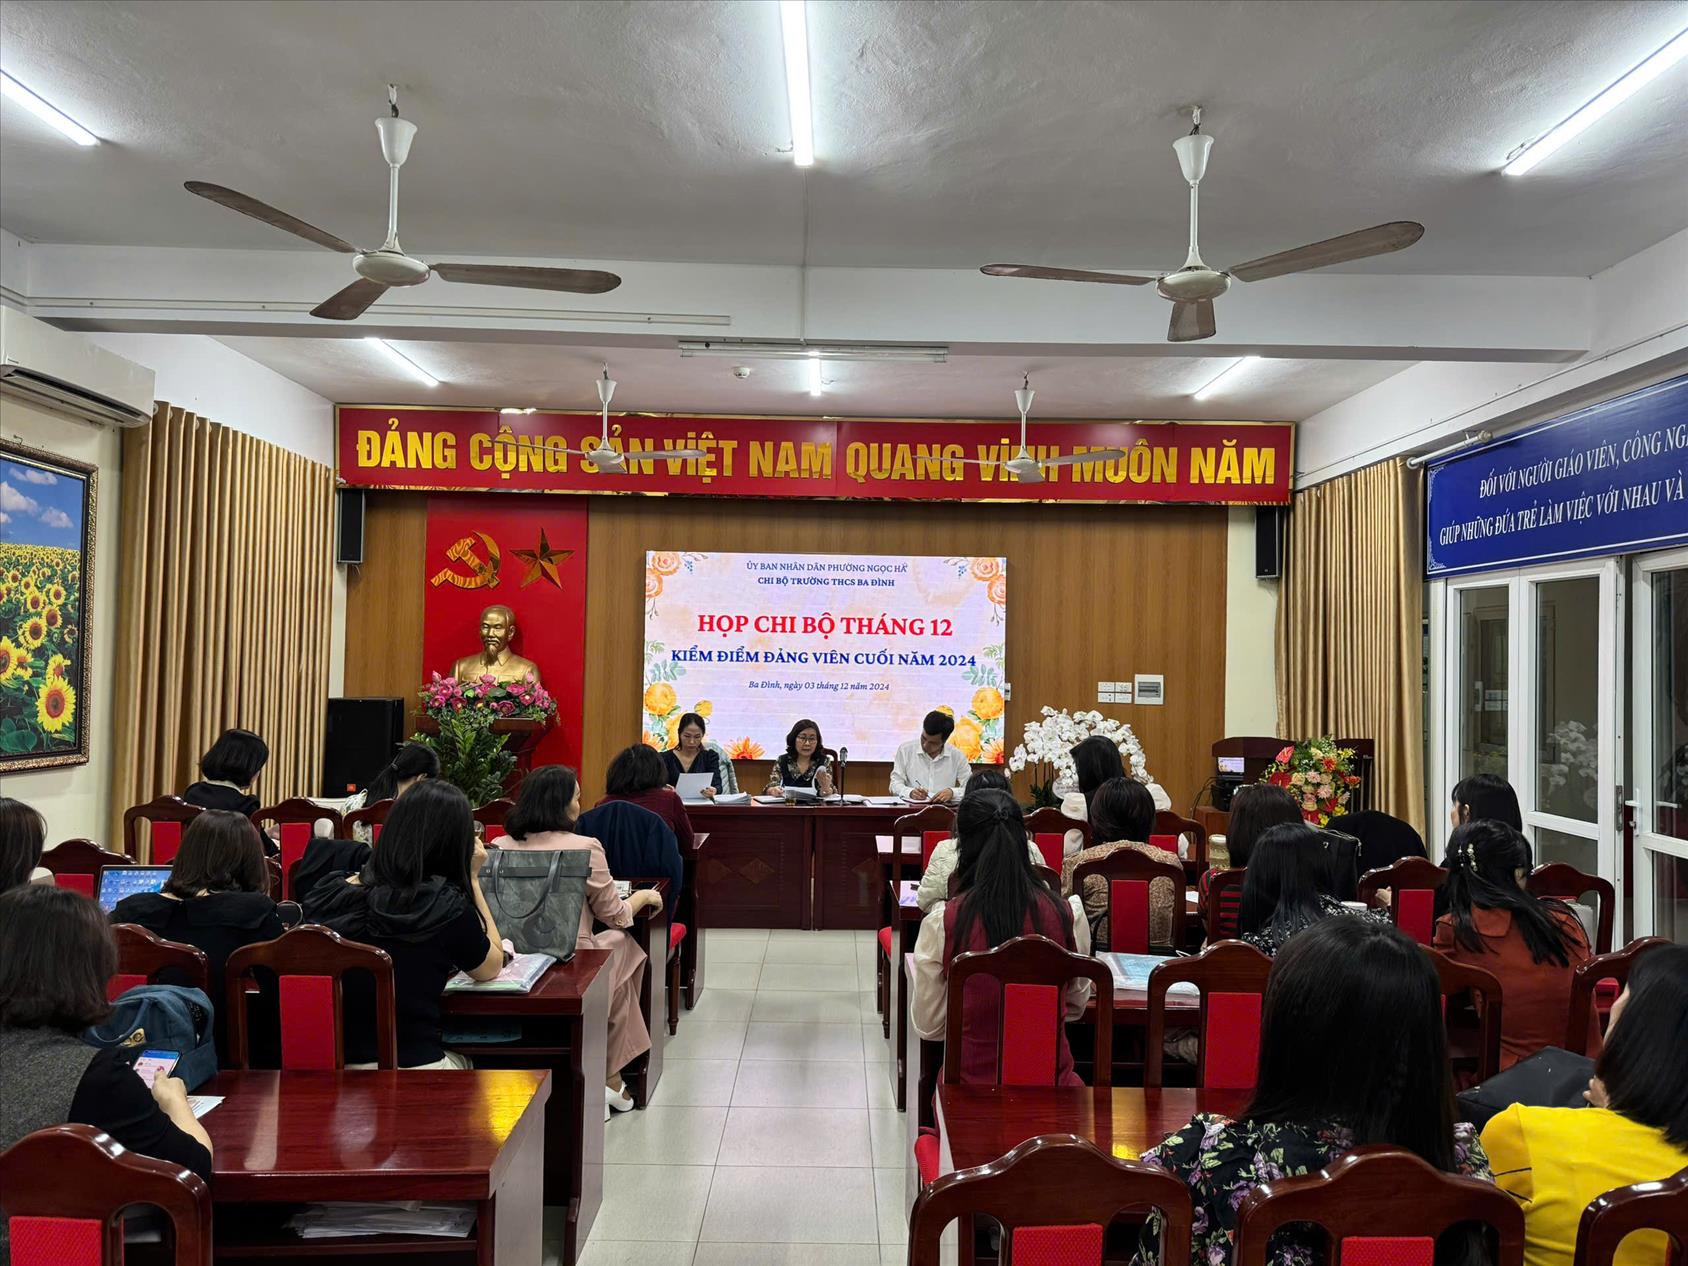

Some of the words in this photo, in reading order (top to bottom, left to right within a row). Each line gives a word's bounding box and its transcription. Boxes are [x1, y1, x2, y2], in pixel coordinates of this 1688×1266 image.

[357, 418, 456, 469] ĐẢNG
[470, 425, 568, 479] CỘNG
[664, 432, 738, 484] VIỆT
[749, 441, 832, 479] NAM
[846, 441, 964, 483] QUANG
[1072, 438, 1177, 484] MUÔN
[1190, 439, 1275, 484] NĂM
[1479, 468, 1497, 498] ĐỐI
[1499, 466, 1517, 493] VỚI
[1518, 457, 1553, 489] NGƯỜI
[1554, 448, 1583, 480] GIÁO
[1586, 439, 1620, 472] VIÊN,
[1622, 429, 1662, 462] CÔNG
[1664, 424, 1688, 452] NG
[1439, 520, 1460, 546] GIÚP
[1494, 507, 1515, 535] ĐỨA
[1517, 499, 1538, 531] TRẺ
[1539, 499, 1564, 527] LÀM
[1566, 490, 1593, 525] VIỆC
[1596, 484, 1619, 516] VỚI
[1621, 480, 1662, 511] NHAU
[1665, 469, 1684, 502] VÀ
[760, 562, 778, 571] BAN
[779, 561, 805, 572] NHÂN
[806, 562, 826, 572] DÂN
[866, 564, 893, 575] NGỌC
[757, 576, 774, 585] CHI
[775, 575, 789, 587] BỘ
[791, 575, 830, 586] TRƯỜNG
[831, 577, 856, 587] THCS
[857, 578, 870, 587] BA
[870, 576, 896, 587] ĐÌNH
[697, 614, 749, 638] HỌP
[754, 615, 797, 634] CHI
[801, 612, 836, 640] BỘ
[840, 613, 925, 636] THÁNG
[930, 618, 953, 637] 12
[671, 645, 713, 662] KIỂM
[717, 645, 760, 663] ĐIỂM
[763, 648, 809, 664] ĐẢNG
[812, 649, 850, 664] VIÊN
[854, 648, 894, 665] CUỐI
[898, 650, 935, 666] NĂM
[939, 654, 976, 667] 2024
[748, 680, 759, 689] Ba
[760, 680, 782, 690] Đình,
[783, 680, 803, 691] ngày
[804, 681, 815, 689] 03
[816, 681, 840, 692] tháng
[840, 682, 849, 690] 12
[850, 682, 868, 690] năm
[869, 682, 890, 691] 2024
